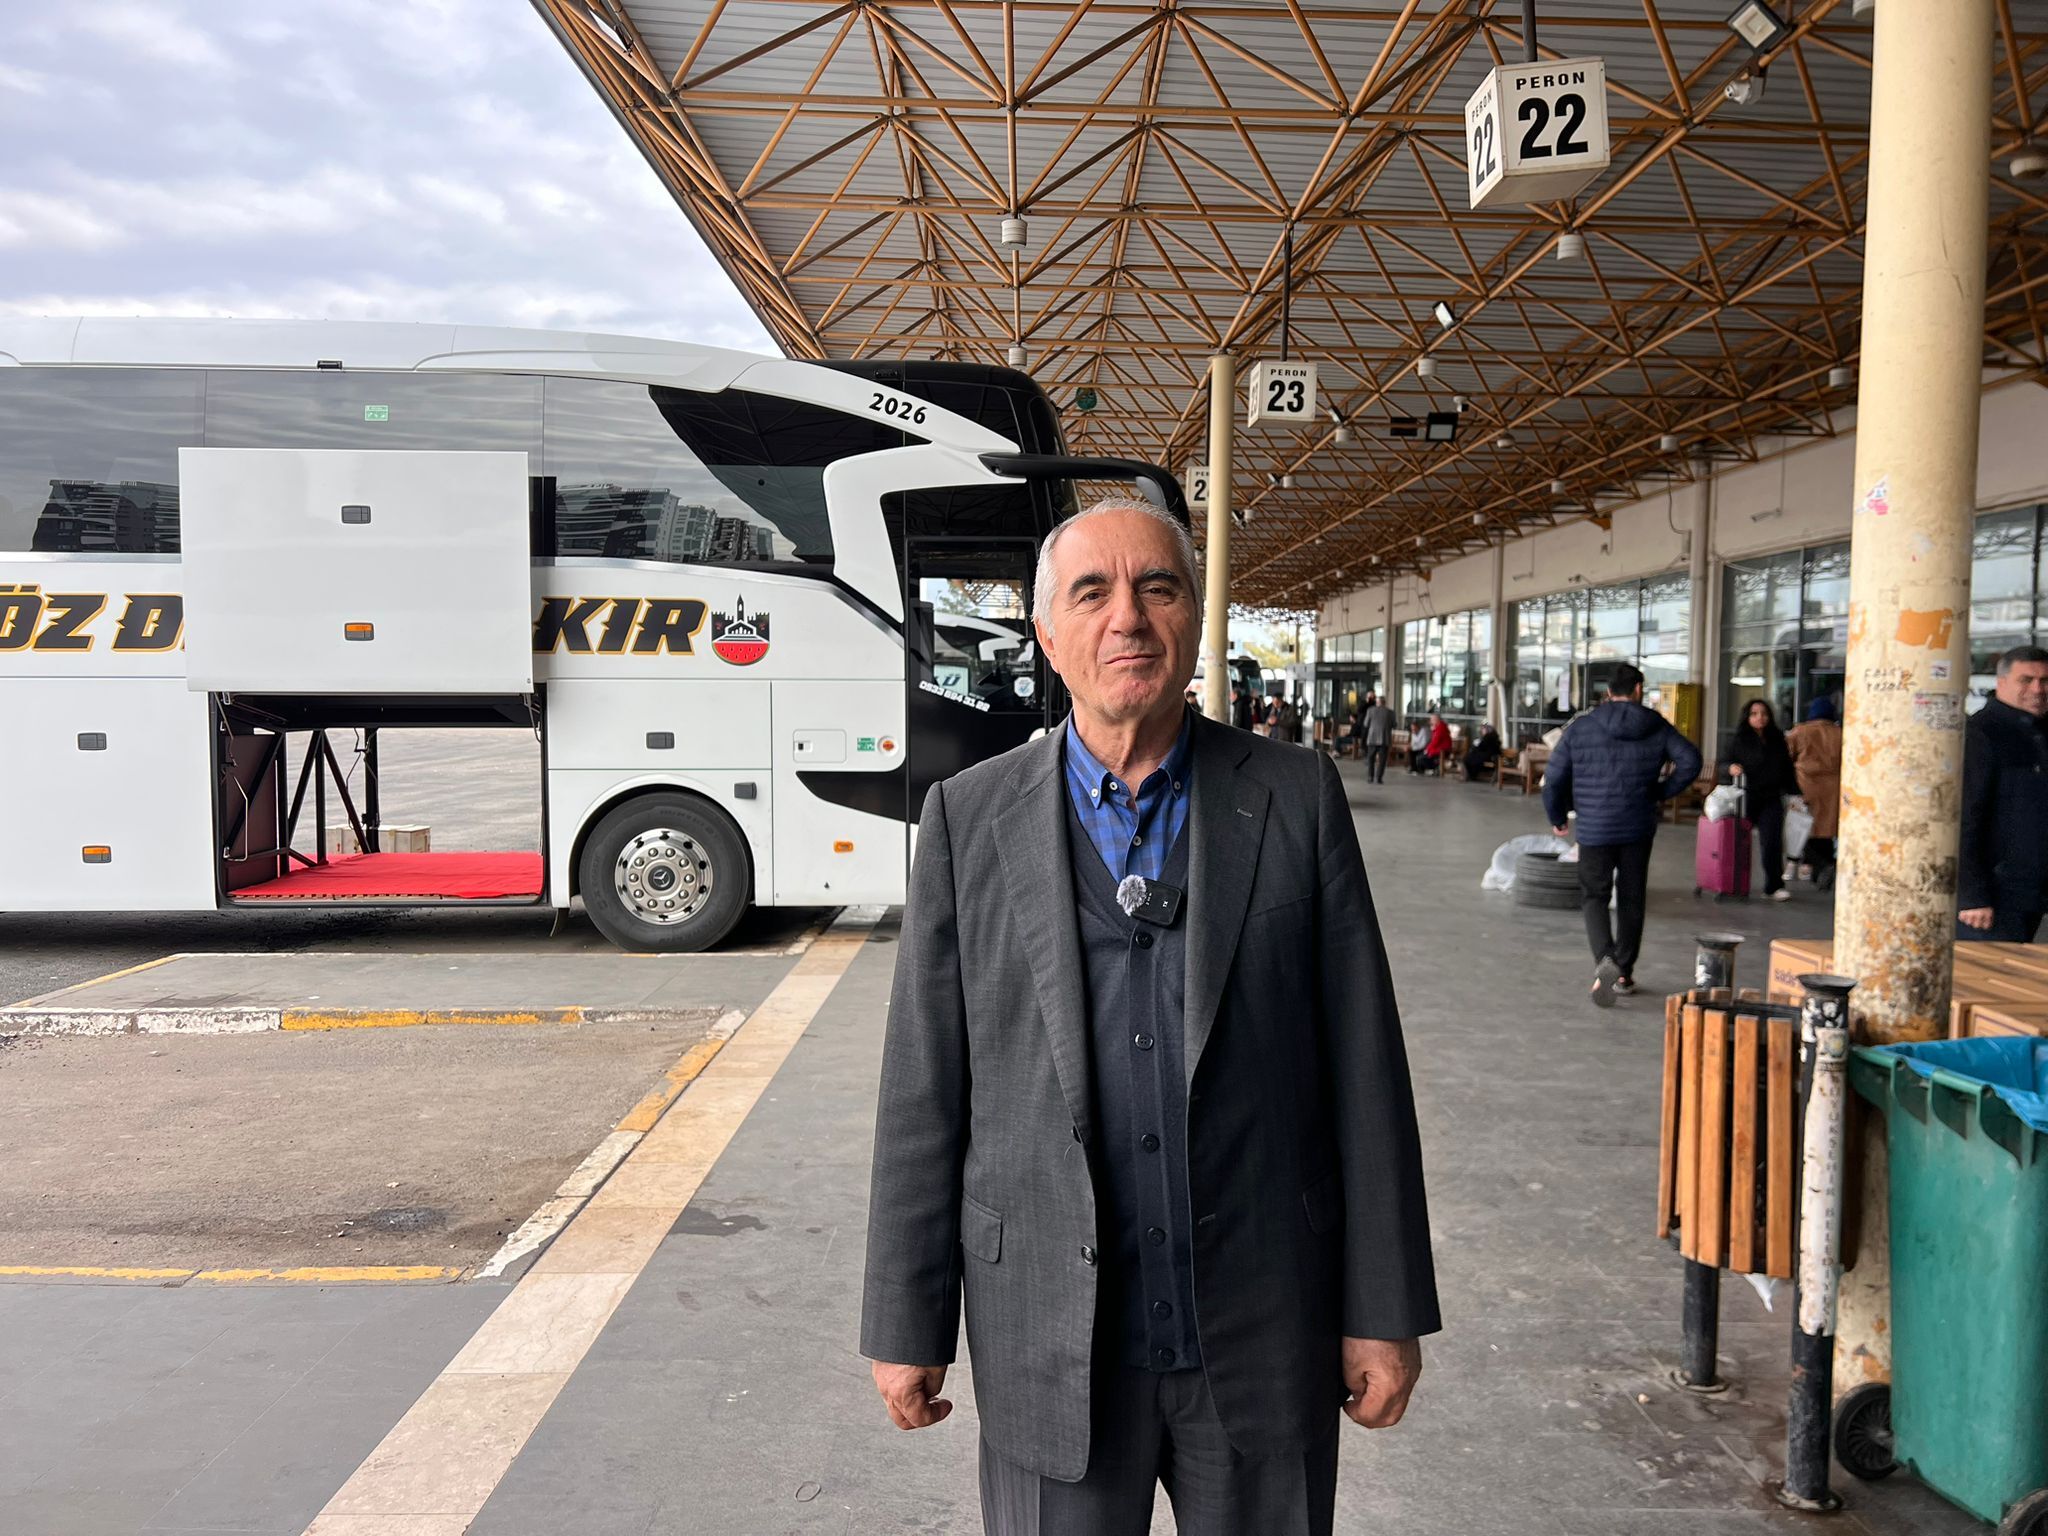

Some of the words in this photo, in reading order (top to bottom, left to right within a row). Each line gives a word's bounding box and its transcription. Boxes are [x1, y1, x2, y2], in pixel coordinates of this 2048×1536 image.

[1516, 71, 1585, 90] PERON
[1471, 89, 1493, 123] PERON
[1518, 93, 1589, 160] 22
[1473, 112, 1496, 189] 22
[1270, 368, 1307, 377] PERON
[868, 392, 928, 425] 2026
[1267, 380, 1305, 413] 23
[1193, 479, 1210, 502] 2
[0, 584, 108, 653] ÖZ
